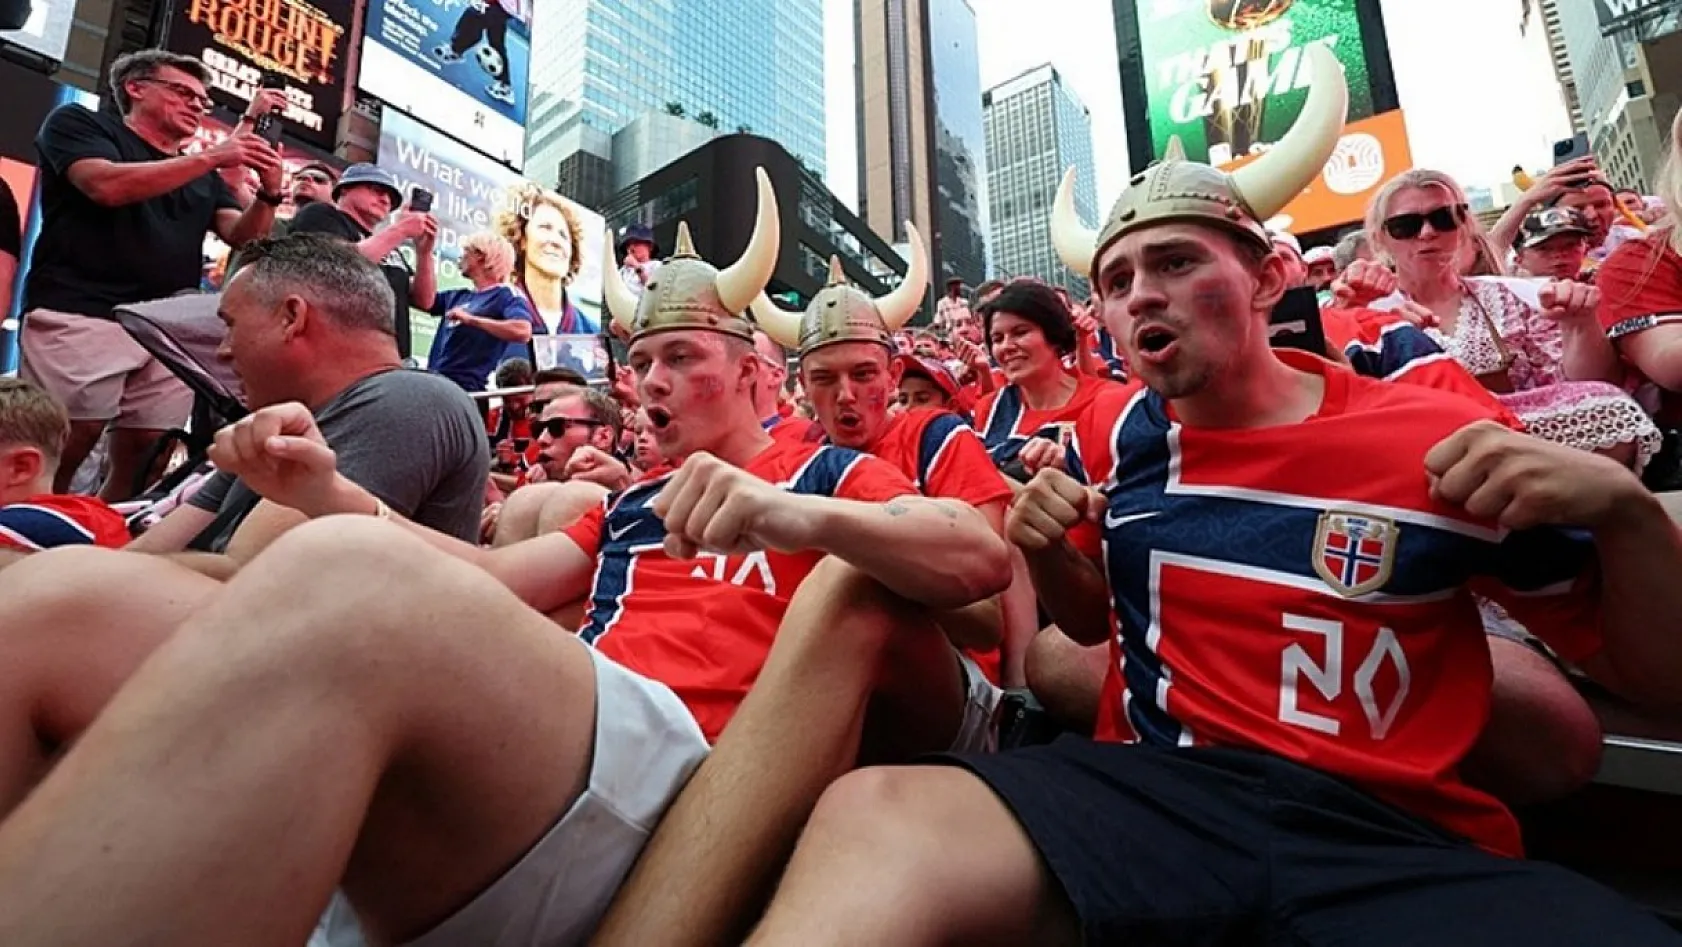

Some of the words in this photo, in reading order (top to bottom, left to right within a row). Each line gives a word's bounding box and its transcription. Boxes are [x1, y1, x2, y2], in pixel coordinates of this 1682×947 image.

[395, 136, 464, 190] What
[447, 191, 488, 226] like
[1278, 611, 1412, 741] 20
